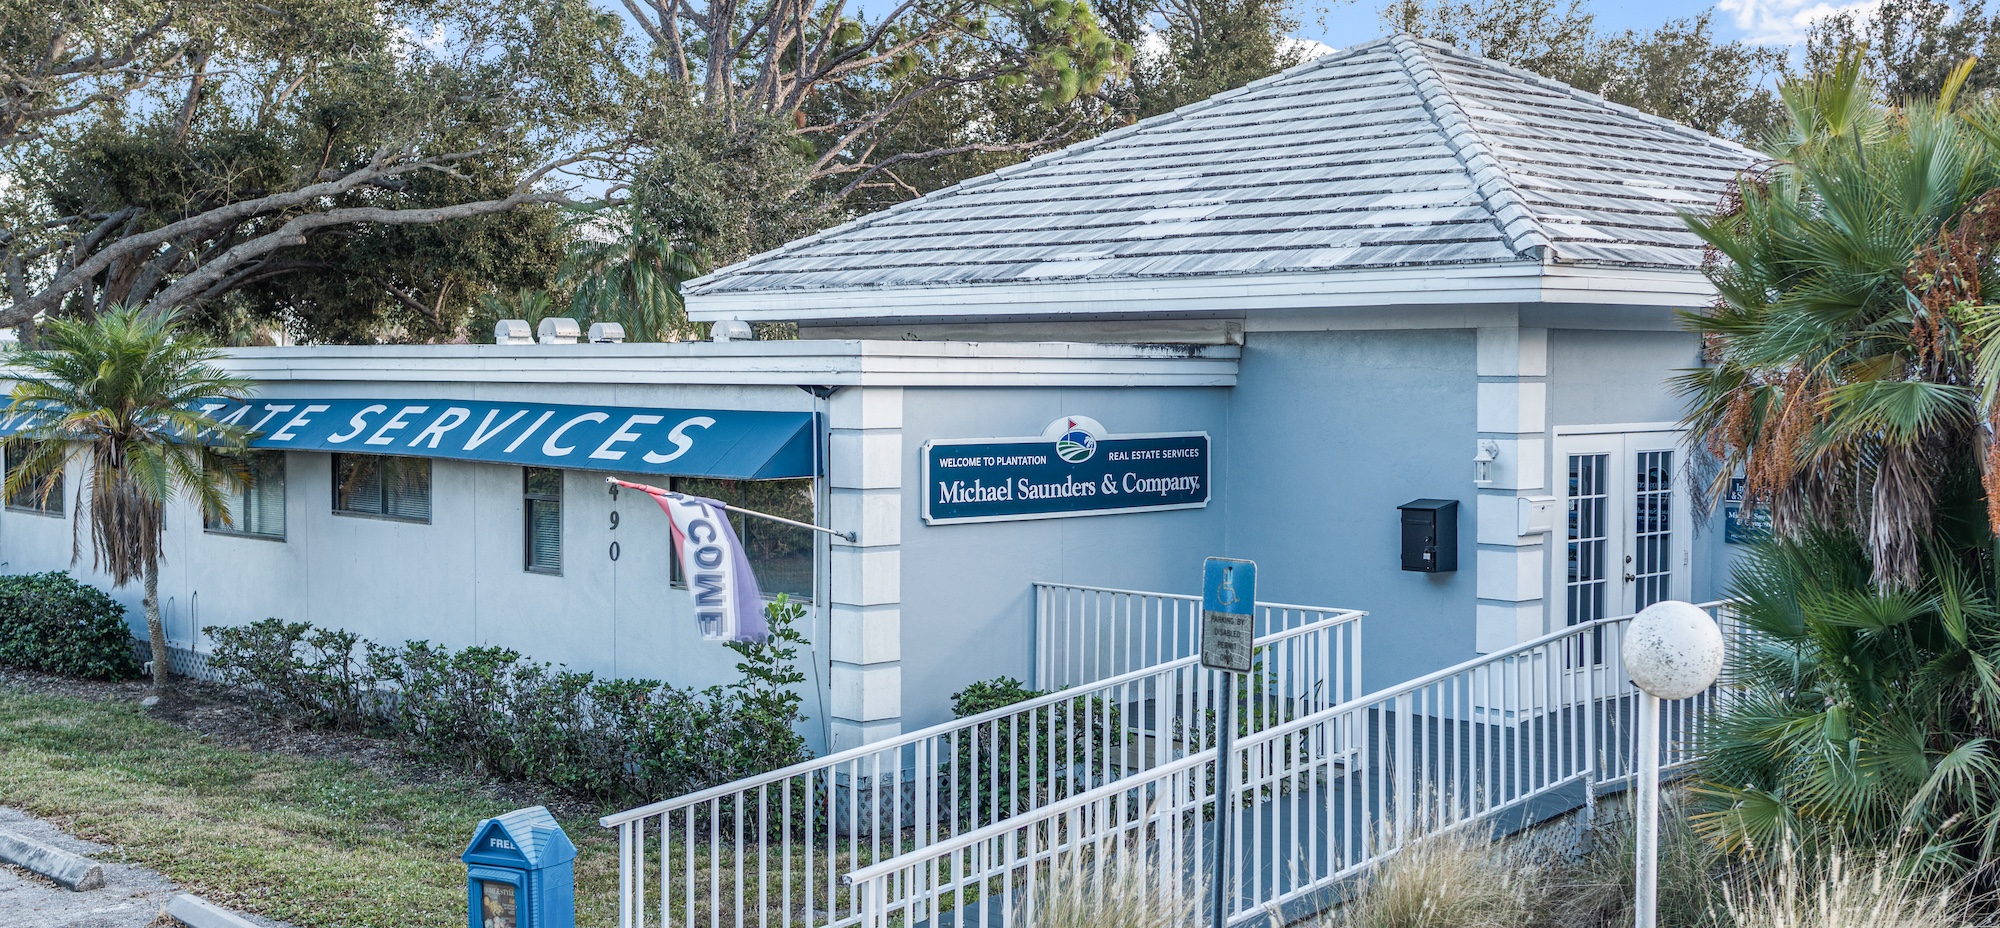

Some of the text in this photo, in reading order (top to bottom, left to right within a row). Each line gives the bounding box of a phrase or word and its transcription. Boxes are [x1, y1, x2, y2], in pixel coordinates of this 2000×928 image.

[327, 403, 717, 464] SERVICES
[1108, 448, 1199, 461] REAL ESTATE SERVICES
[939, 455, 1047, 468] WELCOME TO PLANTATION
[939, 477, 1012, 504] Michael
[1017, 474, 1096, 499] Saunders
[1101, 473, 1119, 495] &
[1210, 615, 1245, 626] PARKING BY
[1214, 628, 1241, 638] DISABLED
